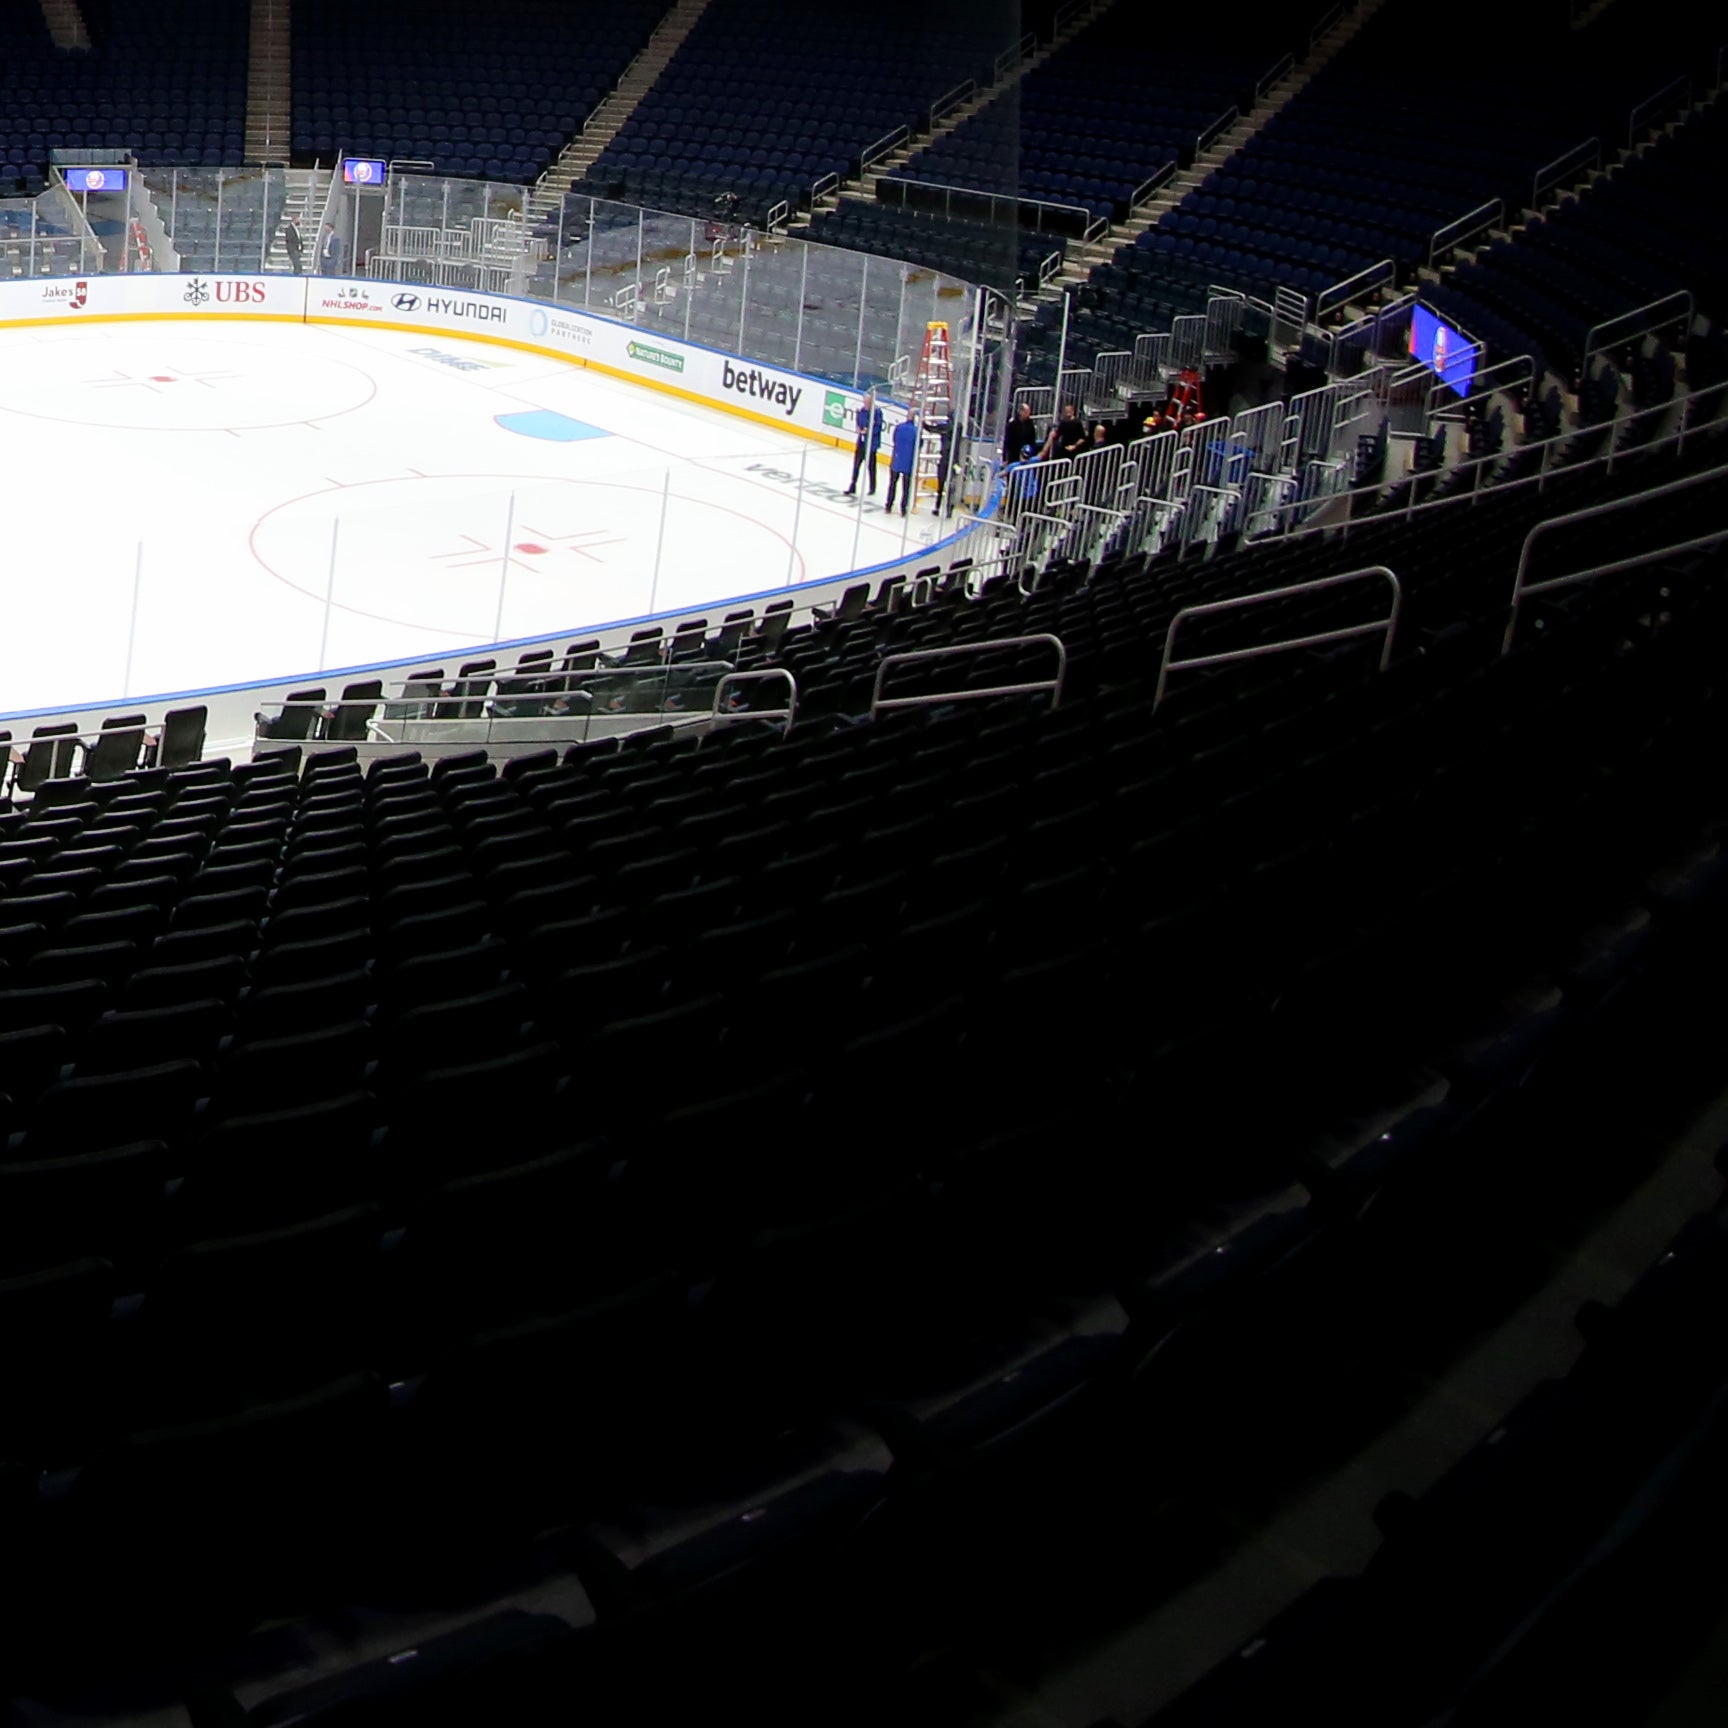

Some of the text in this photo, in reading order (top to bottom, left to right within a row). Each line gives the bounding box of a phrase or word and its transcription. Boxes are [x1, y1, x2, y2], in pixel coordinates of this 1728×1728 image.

[42, 286, 73, 299] Jake's
[215, 281, 266, 304] UBS
[426, 297, 507, 324] HYUNDAI
[722, 360, 802, 415] betway
[744, 462, 885, 515] verizon
